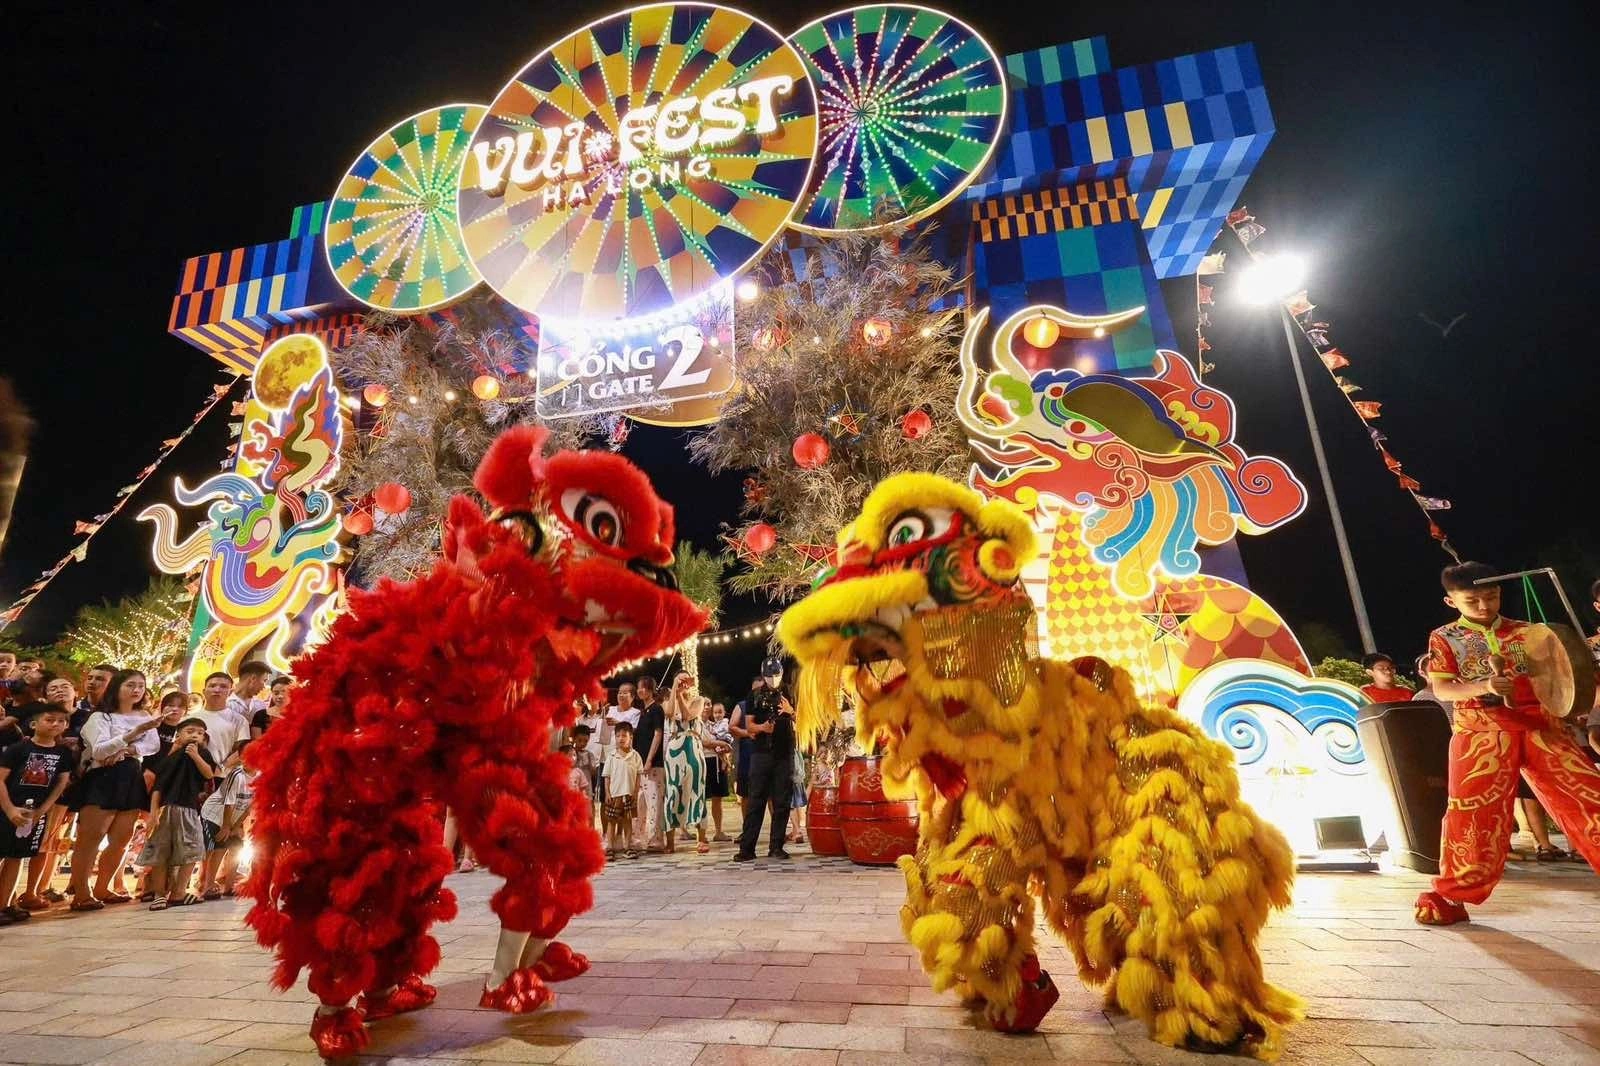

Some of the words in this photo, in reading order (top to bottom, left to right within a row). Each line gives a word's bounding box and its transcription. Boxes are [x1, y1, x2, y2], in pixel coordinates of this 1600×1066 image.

[619, 75, 793, 163] FEST
[543, 182, 586, 207] HA
[607, 154, 711, 195] LONG
[589, 374, 654, 400] GATE
[658, 325, 712, 390] 2
